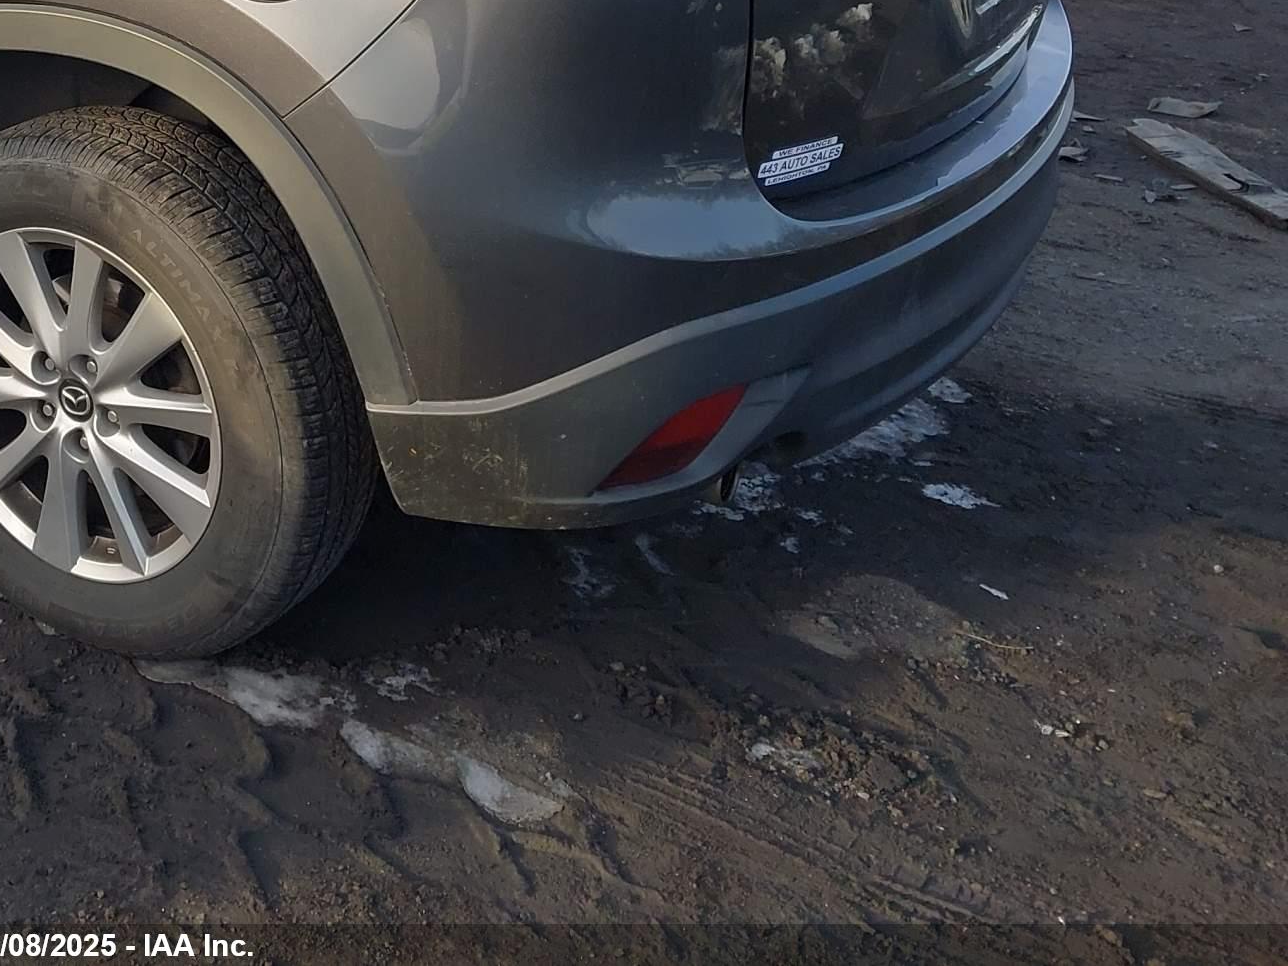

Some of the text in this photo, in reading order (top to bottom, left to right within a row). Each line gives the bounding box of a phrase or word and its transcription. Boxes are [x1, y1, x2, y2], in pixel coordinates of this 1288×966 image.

[795, 139, 832, 153] FINANCE
[760, 146, 841, 175] 443 AUTO SALES
